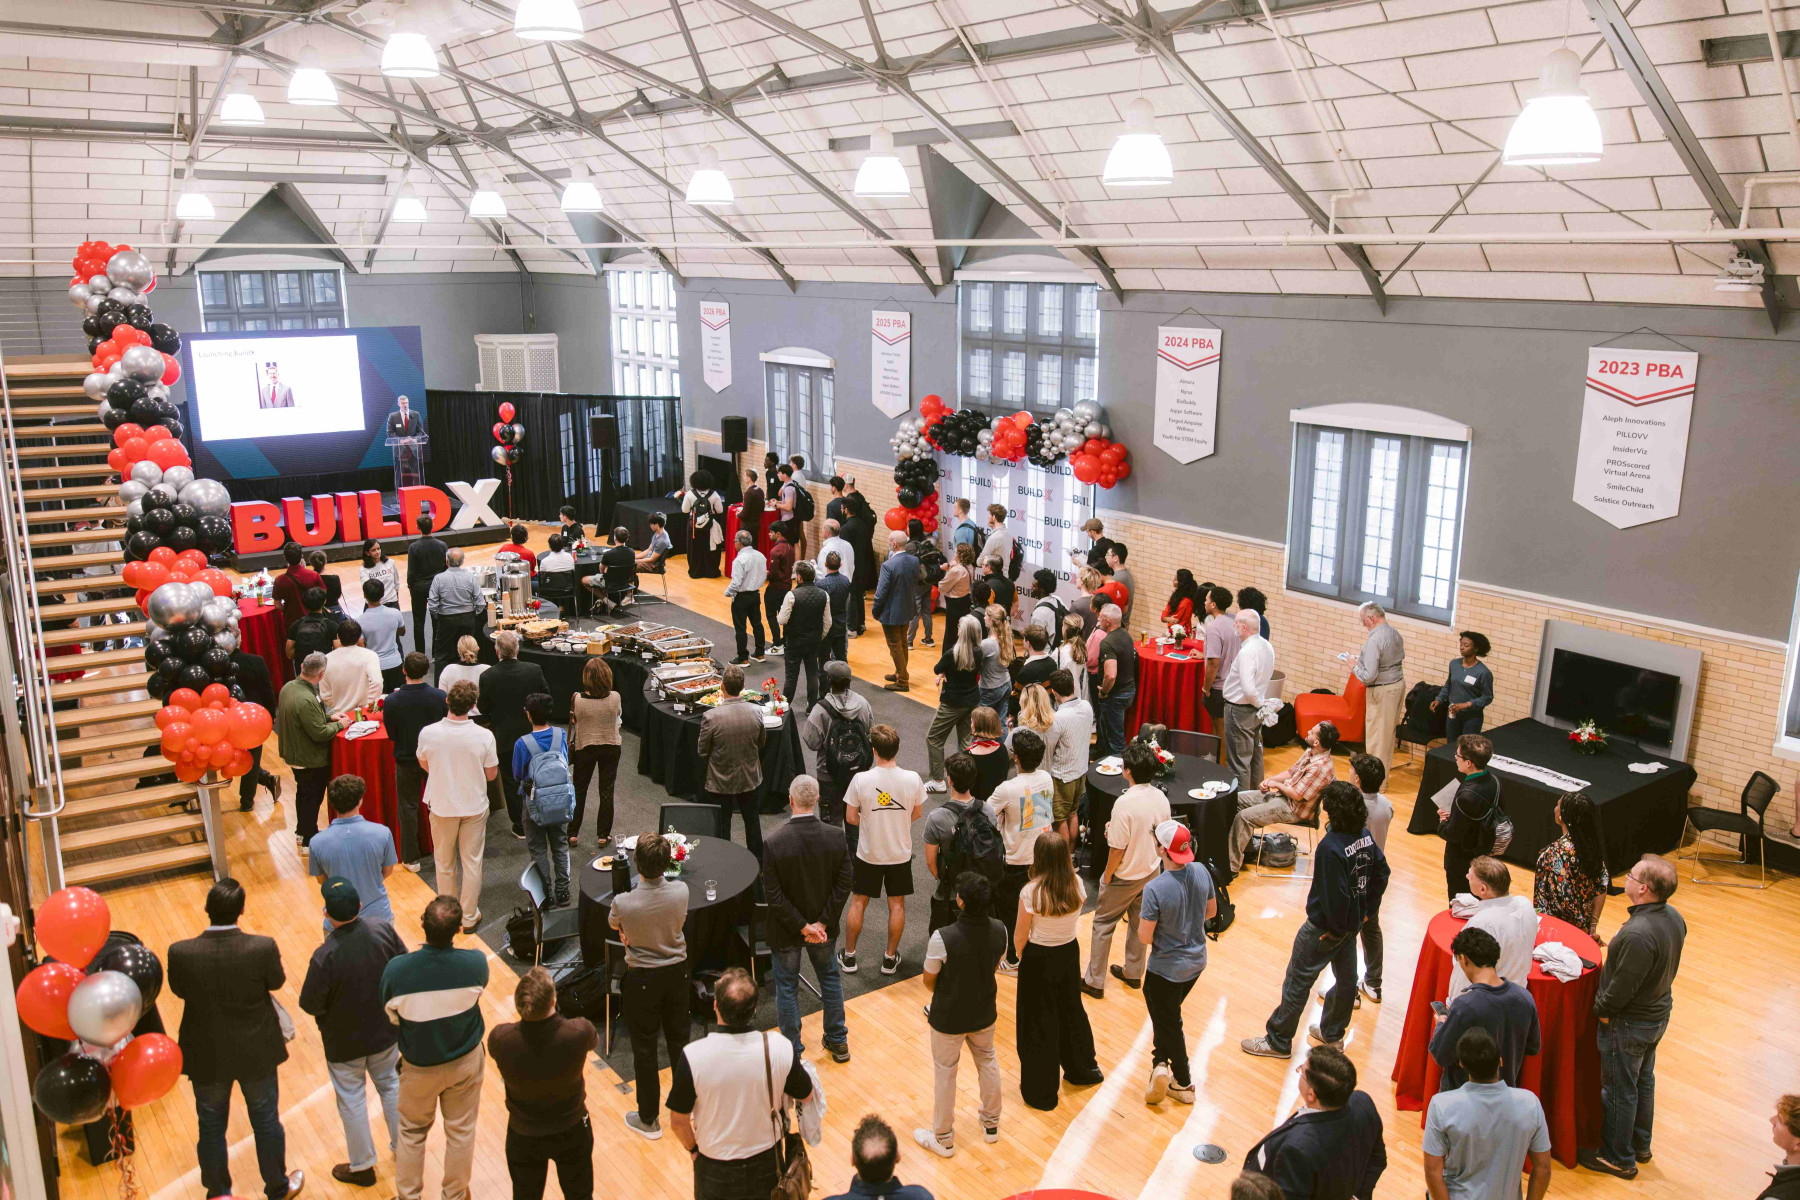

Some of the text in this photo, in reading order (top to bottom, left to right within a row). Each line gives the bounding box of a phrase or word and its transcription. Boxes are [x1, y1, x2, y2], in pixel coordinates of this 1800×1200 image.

[876, 318, 906, 328] 2025 PBA
[1165, 336, 1214, 350] 2024 PBA
[1598, 360, 1684, 378] 2023 PBA
[1602, 414, 1666, 427] Aleph Innovations
[1612, 446, 1648, 455] InsiderViz
[1604, 468, 1650, 480] Virtual Arena
[1606, 483, 1644, 494] SmileChild
[1594, 495, 1654, 510] Solstice Outreach
[230, 478, 504, 555] BUILDX
